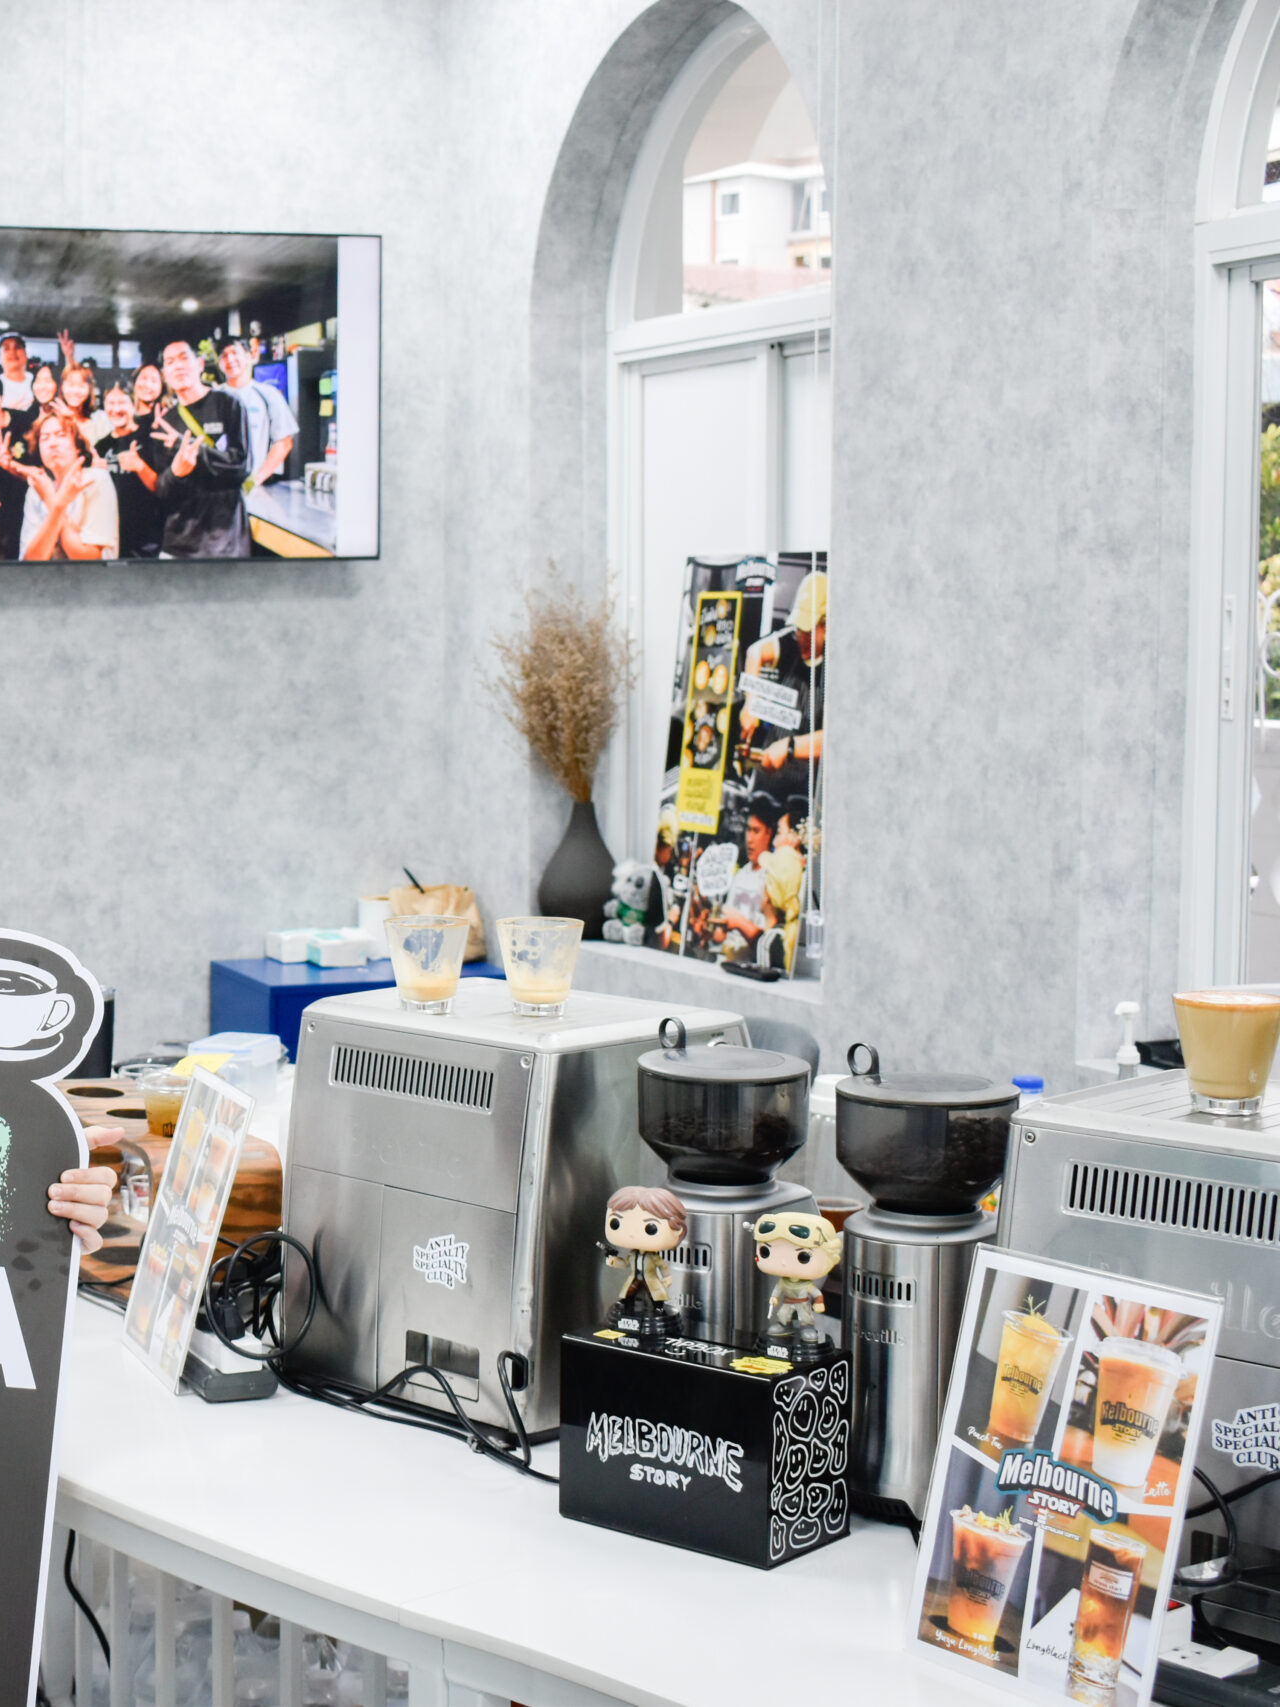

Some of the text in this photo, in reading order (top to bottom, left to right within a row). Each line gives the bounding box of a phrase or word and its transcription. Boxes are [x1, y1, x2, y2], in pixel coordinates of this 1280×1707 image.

[415, 1244, 468, 1262] SPECIALTY
[428, 1237, 453, 1251] ANTI
[415, 1259, 466, 1281] SPECIALTY
[1236, 1406, 1277, 1426] ANTI
[1215, 1421, 1280, 1438] SPECIAL
[586, 1411, 744, 1493] MELBOURNE
[1215, 1435, 1280, 1452] SPECIAL
[629, 1463, 692, 1492] STORY
[999, 1454, 1114, 1518] Melbourne
[1143, 1480, 1171, 1497] Latte
[1028, 1491, 1081, 1517] STORY
[1026, 1639, 1068, 1660] Longblack
